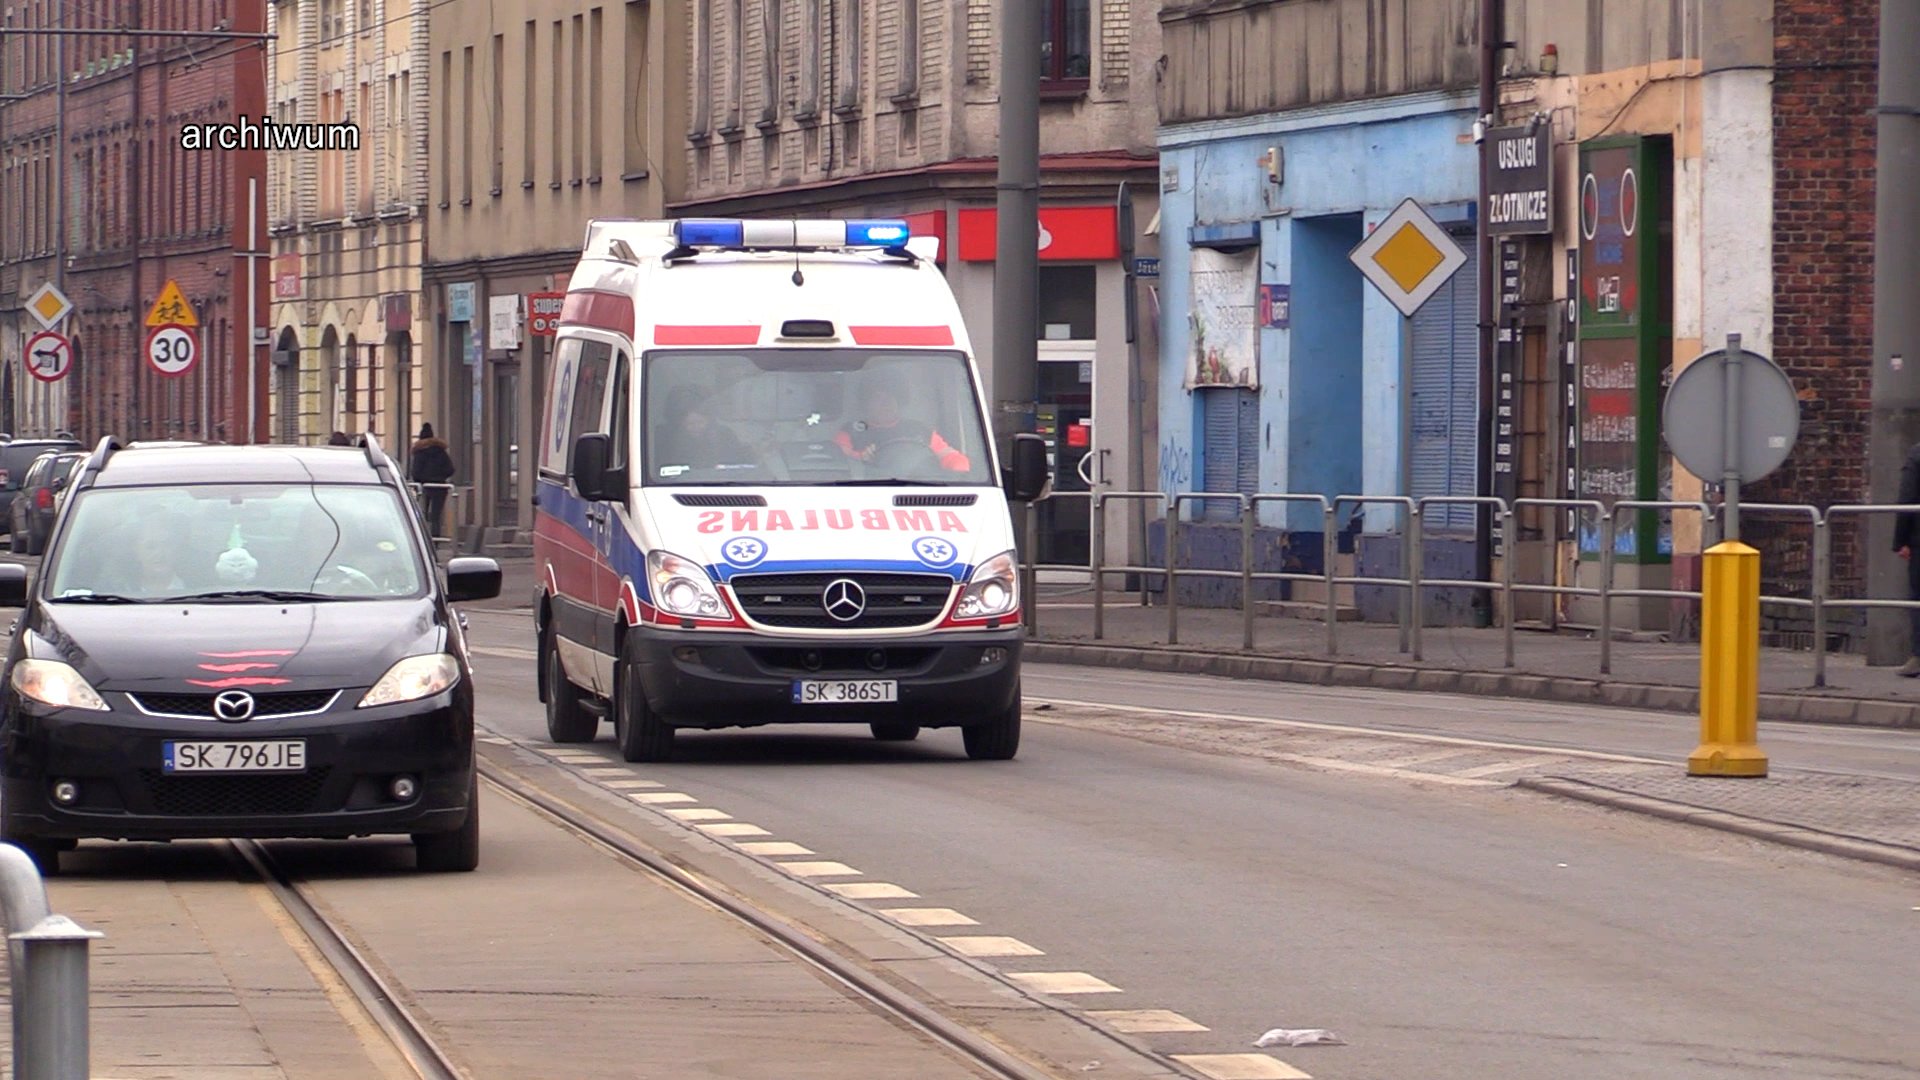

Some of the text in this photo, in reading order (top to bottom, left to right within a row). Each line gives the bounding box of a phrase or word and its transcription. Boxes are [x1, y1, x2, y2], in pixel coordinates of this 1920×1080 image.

[1498, 137, 1537, 169] USŁUGI
[1489, 190, 1547, 223] ZŁOTNICZE
[154, 337, 191, 363] 30
[805, 683, 829, 701] SK
[836, 682, 893, 700] 386ST
[179, 744, 214, 768] SK
[224, 743, 302, 768] 796JE
